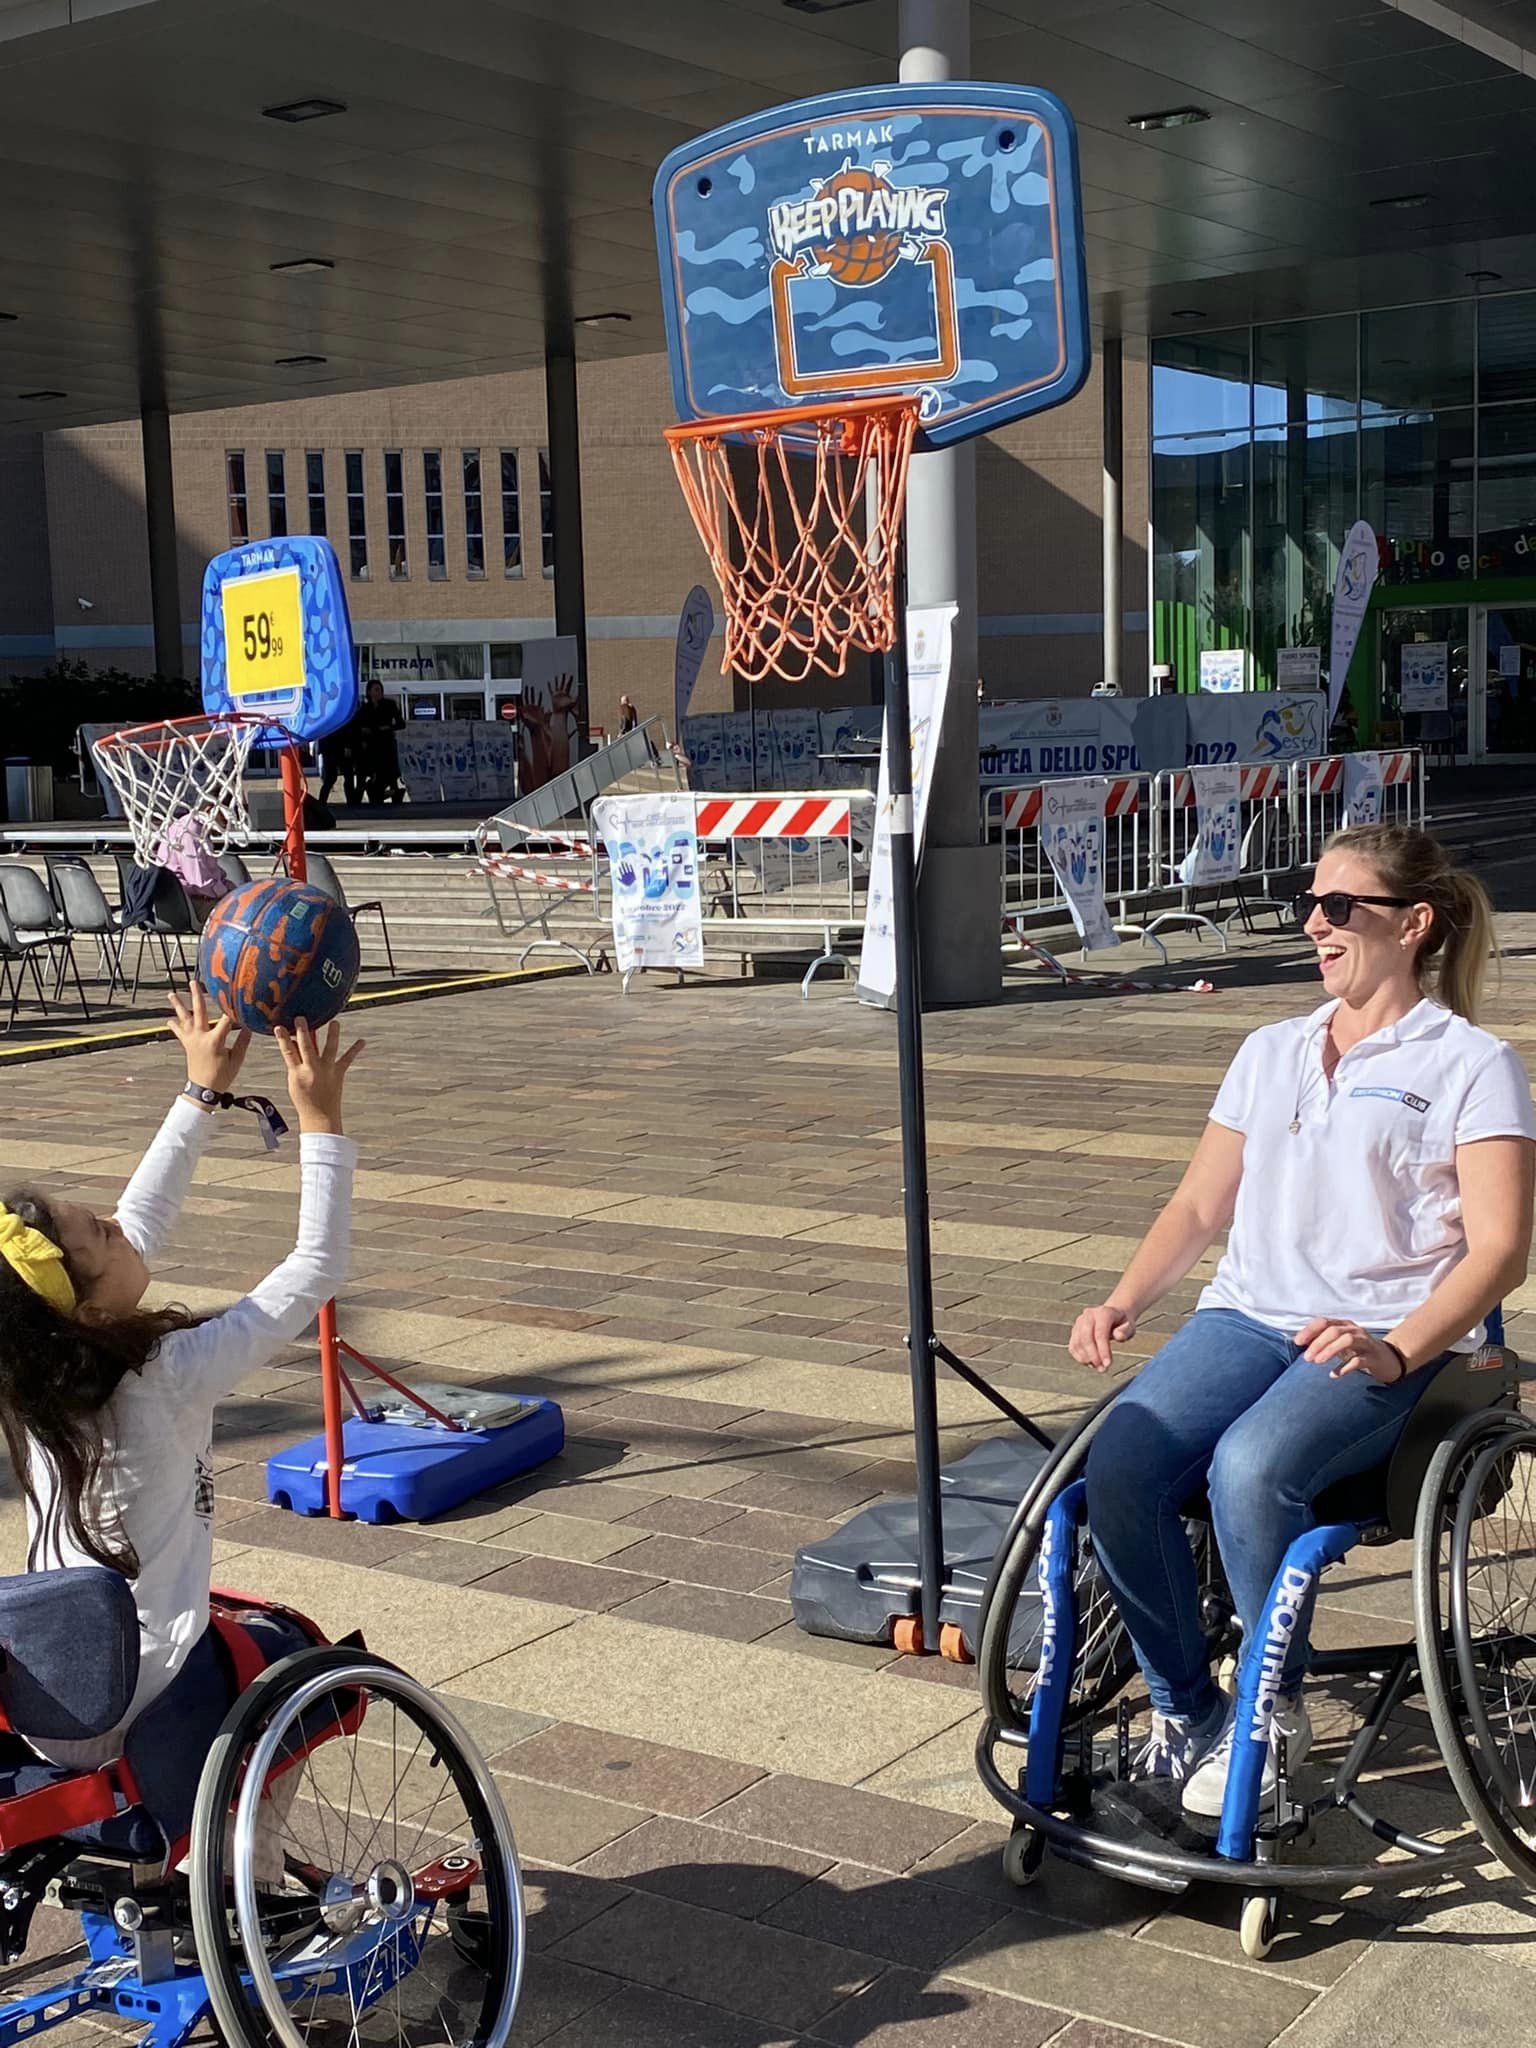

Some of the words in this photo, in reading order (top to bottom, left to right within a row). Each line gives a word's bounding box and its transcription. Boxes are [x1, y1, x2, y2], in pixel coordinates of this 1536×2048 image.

[803, 125, 894, 155] TARMAK
[771, 197, 839, 258] KEEP
[837, 187, 947, 237] PLAYING
[241, 549, 275, 567] TARMAK
[372, 657, 434, 670] ENTRATA
[979, 748, 1033, 775] OPEA
[1040, 745, 1097, 773] DELLO
[1102, 744, 1141, 771] SPO
[1250, 1565, 1312, 1742] DECATHLON
